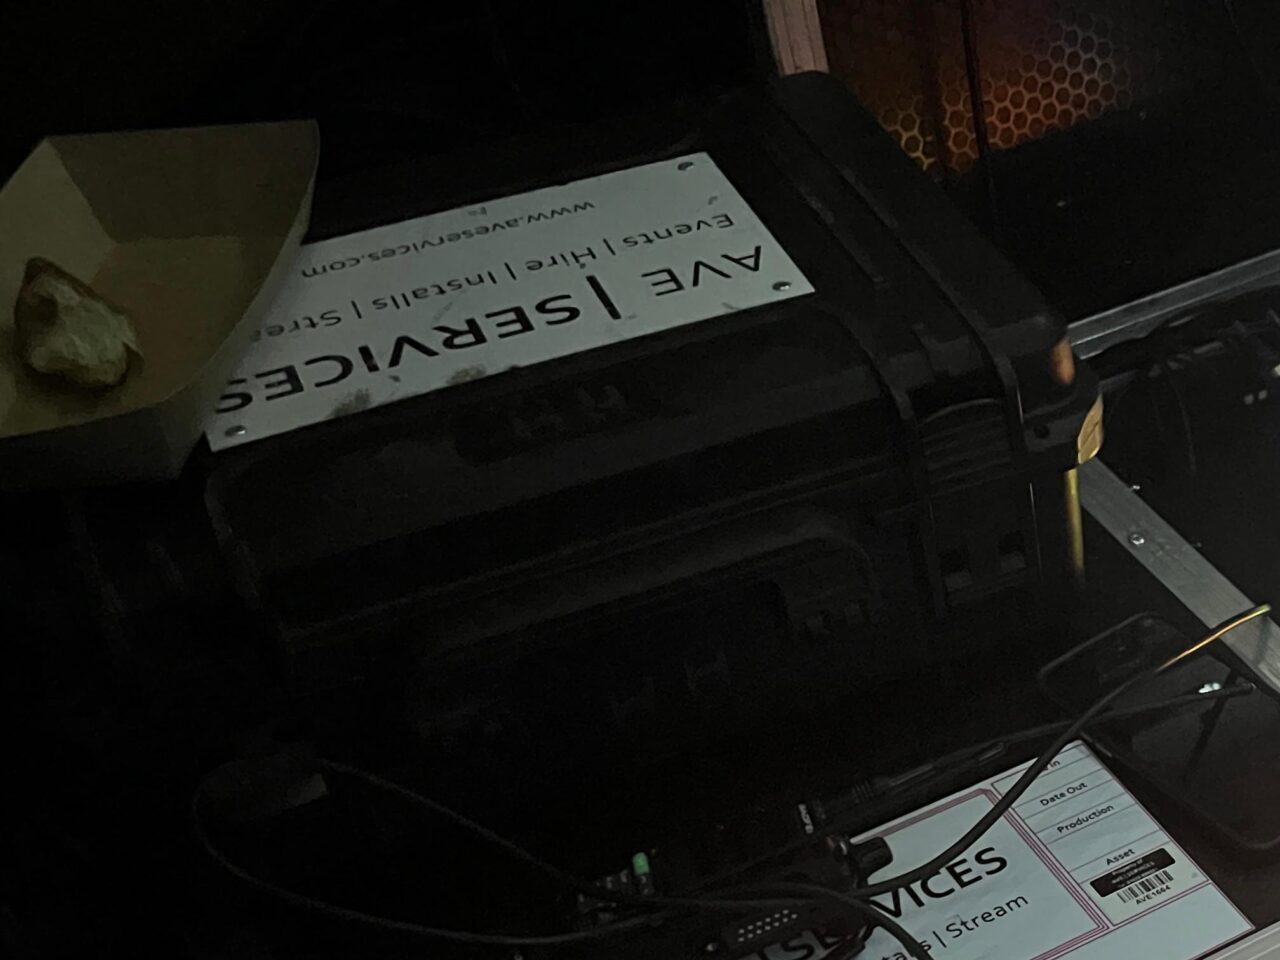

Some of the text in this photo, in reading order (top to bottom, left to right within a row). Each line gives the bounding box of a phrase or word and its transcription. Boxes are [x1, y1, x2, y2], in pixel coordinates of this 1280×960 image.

[301, 200, 595, 278] www.aveservices.com
[622, 214, 734, 248] Events
[526, 246, 596, 274] Hire
[641, 245, 763, 295] AVE
[373, 270, 497, 311] Installs
[1040, 782, 1088, 806] Date Out
[1056, 804, 1115, 833] Production
[1106, 848, 1135, 865] Asset
[946, 893, 1030, 941] Stream
